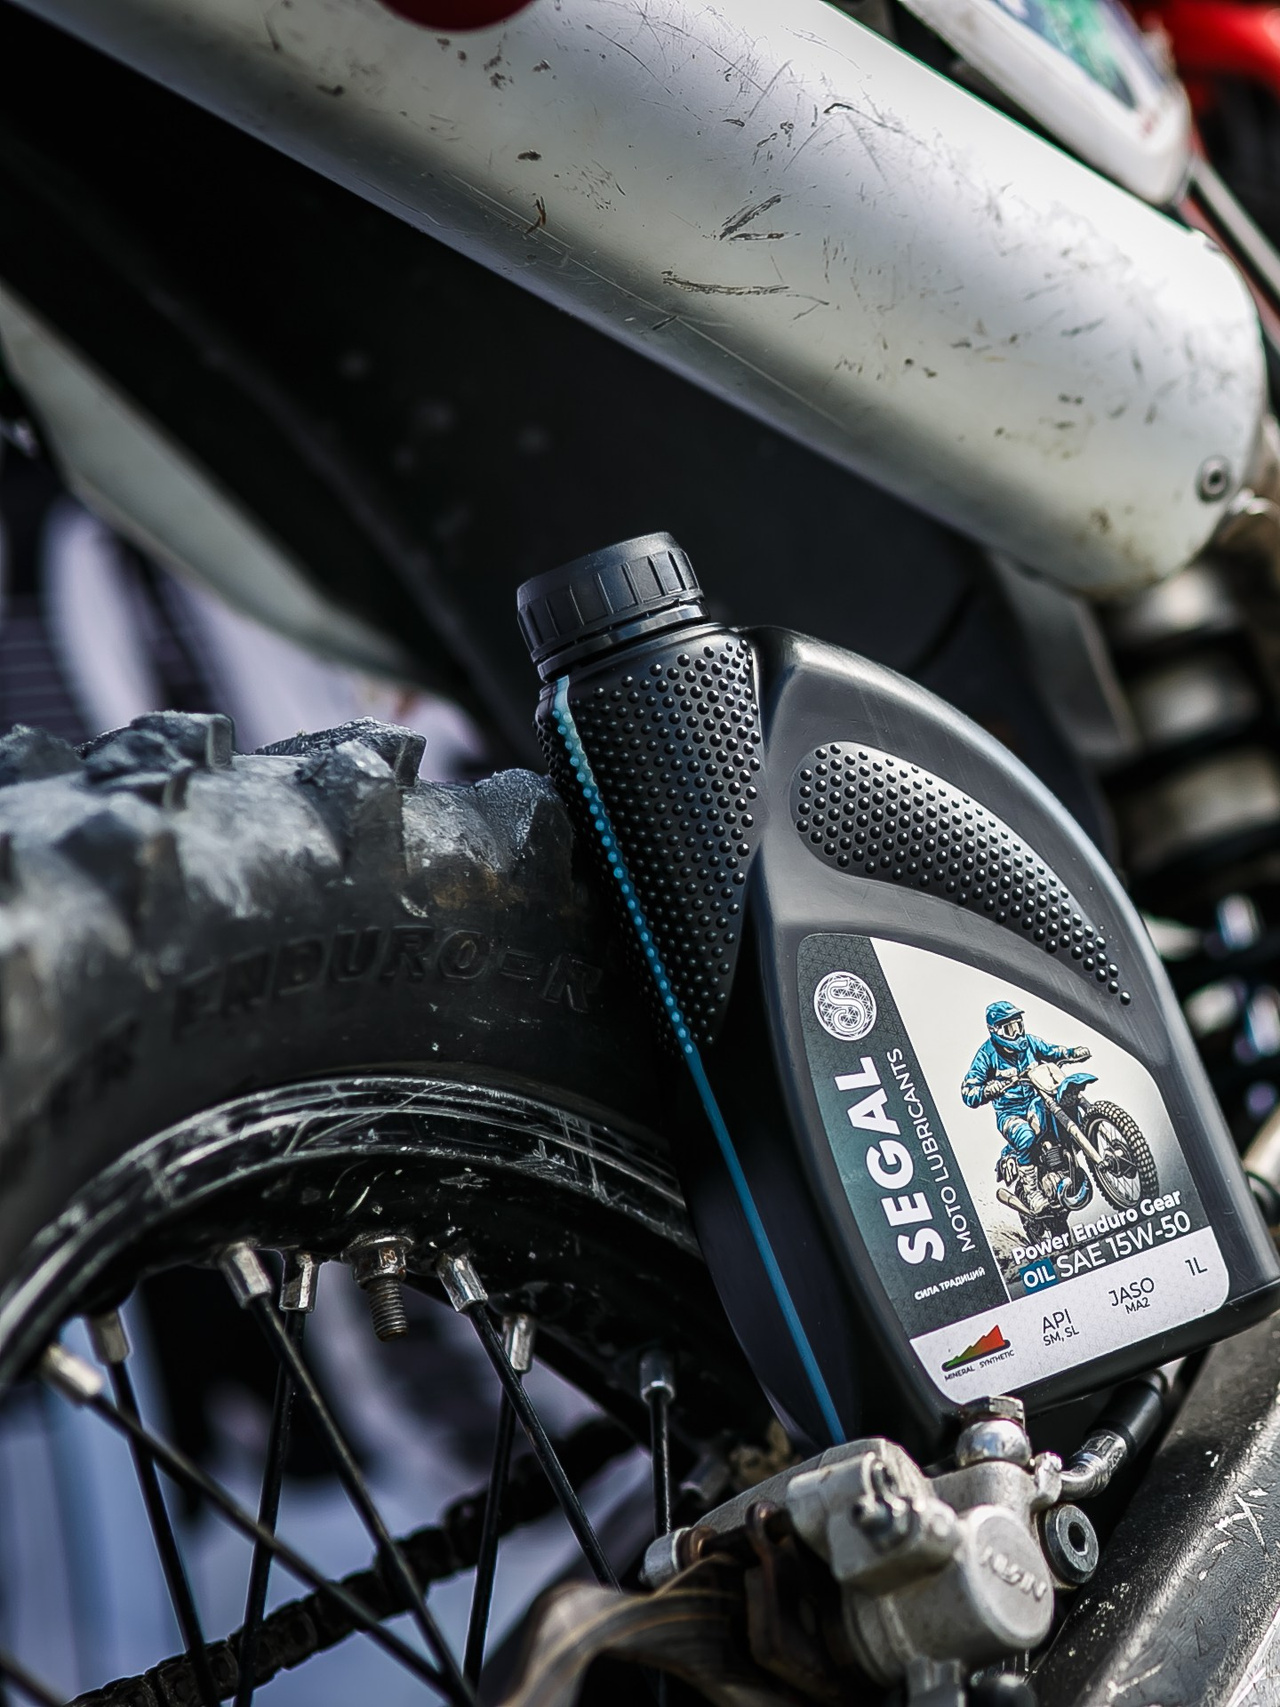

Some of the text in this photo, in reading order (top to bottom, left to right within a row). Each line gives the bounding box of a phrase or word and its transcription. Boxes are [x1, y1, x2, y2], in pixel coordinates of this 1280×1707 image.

[834, 1056, 945, 1264] SEGAL
[886, 1048, 976, 1252] MOTO LUBRICANTS
[1011, 1190, 1181, 1265] Power Enduro Gear
[1023, 1210, 1191, 1289] OIL SAE 15W-50
[1185, 1257, 1208, 1276] 1L
[914, 1266, 986, 1301] СИЛА ТРАДИЦИЙ
[1108, 1277, 1155, 1307] JASO
[1042, 1308, 1072, 1334] API
[1125, 1297, 1150, 1315] MA2
[1043, 1325, 1080, 1346] SM, SL
[944, 1350, 1015, 1381] MINERAL SYNTHETIC
